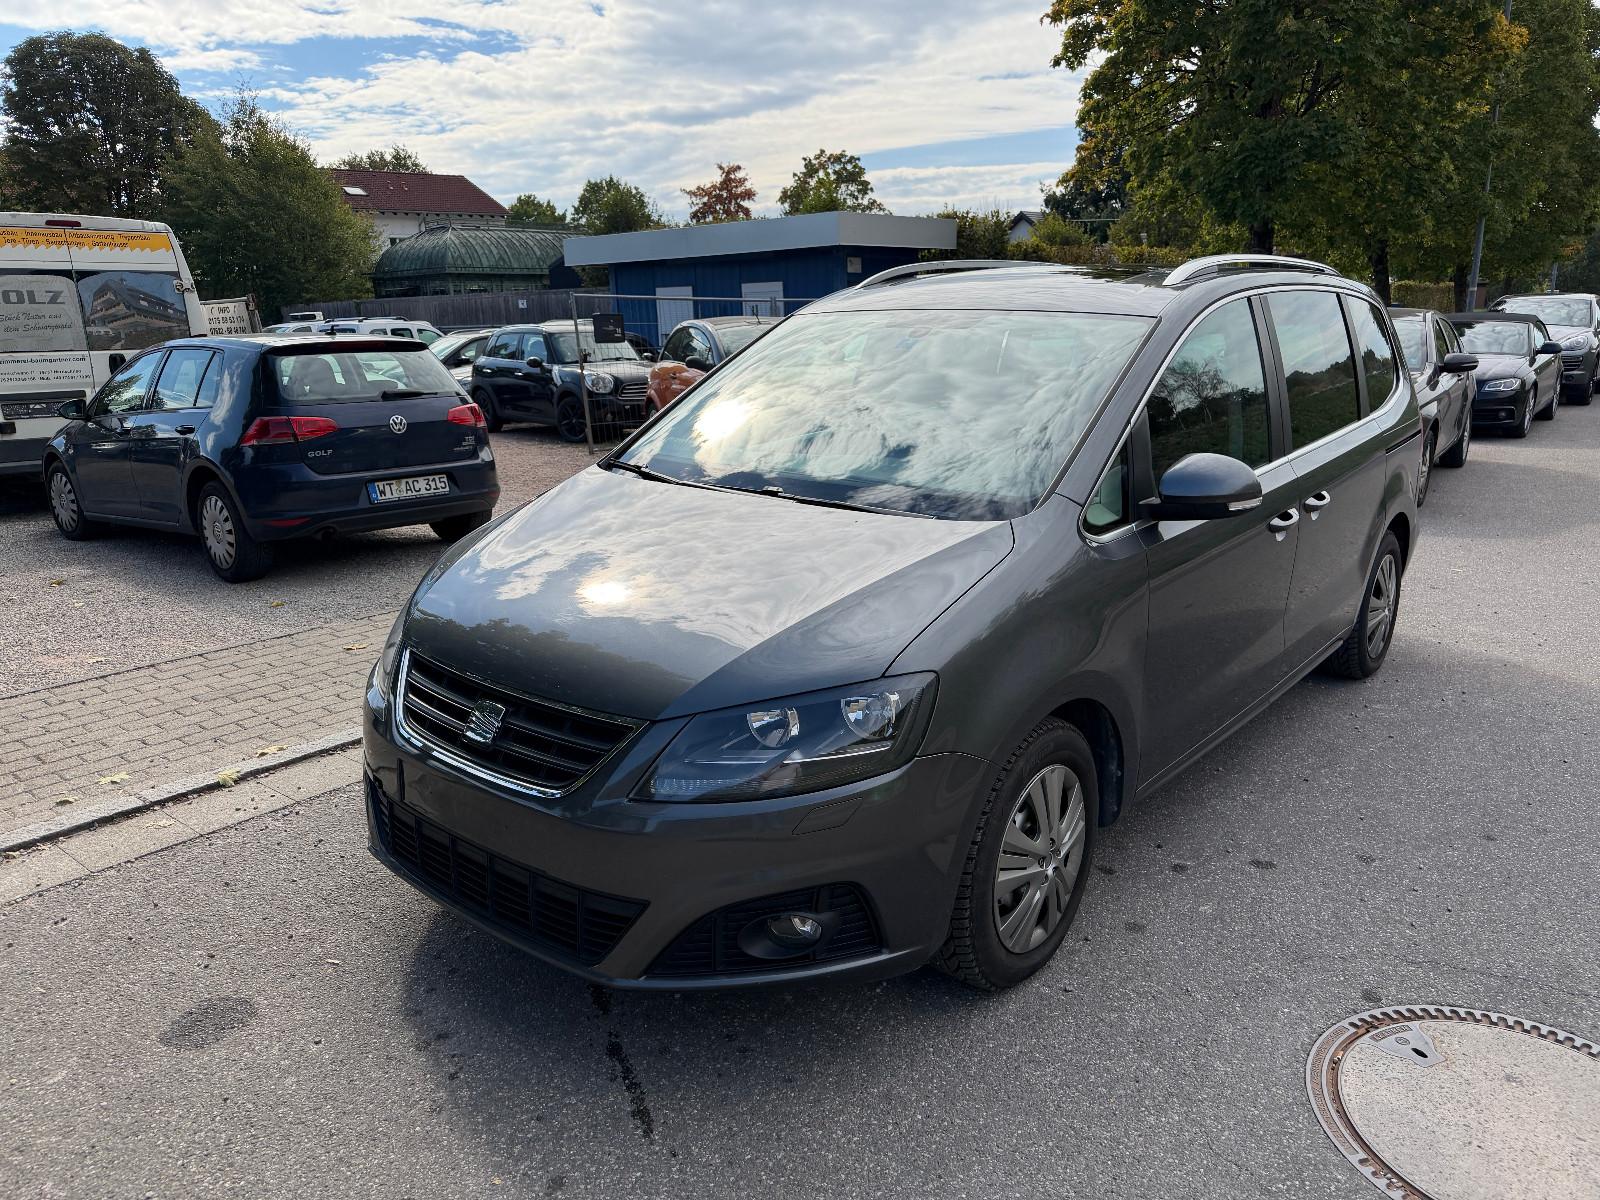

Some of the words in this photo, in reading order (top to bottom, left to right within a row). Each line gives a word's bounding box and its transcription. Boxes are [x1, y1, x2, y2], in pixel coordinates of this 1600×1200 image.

[0, 290, 65, 304] OLZ
[307, 449, 333, 458] GOLF
[376, 482, 394, 498] WT
[405, 479, 421, 495] AC
[423, 476, 447, 492] 315
